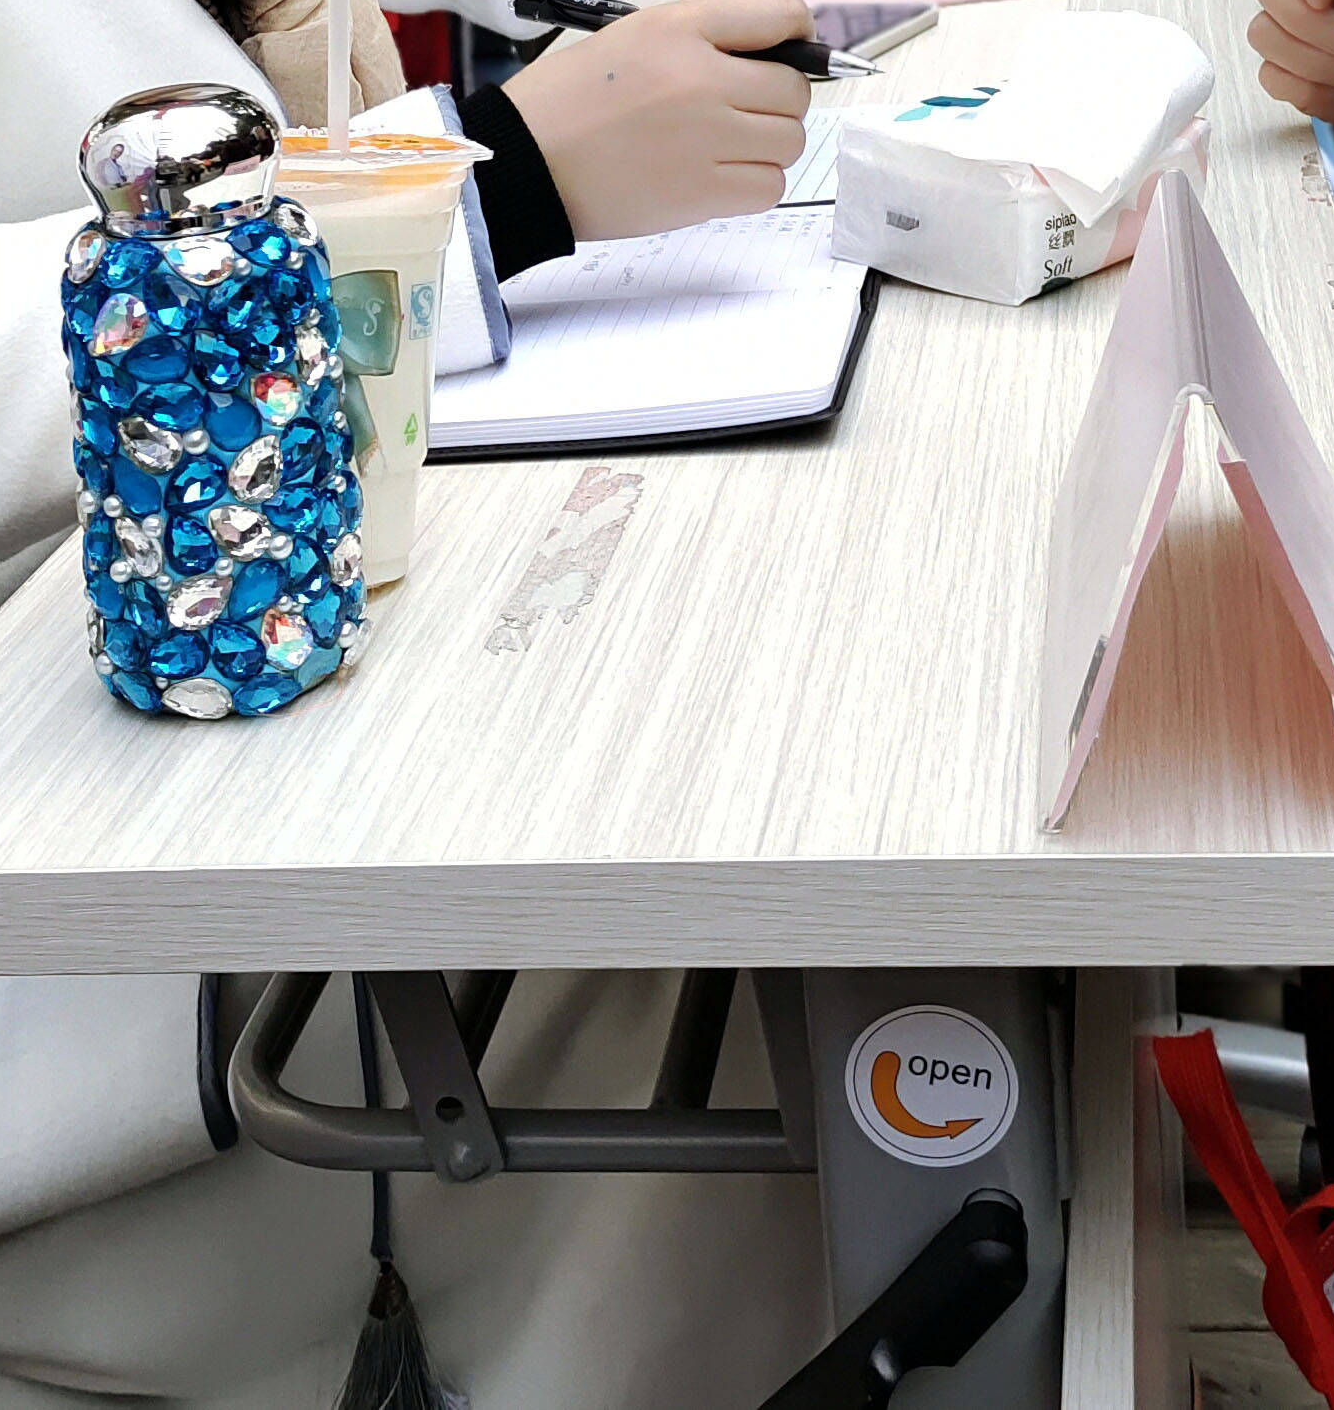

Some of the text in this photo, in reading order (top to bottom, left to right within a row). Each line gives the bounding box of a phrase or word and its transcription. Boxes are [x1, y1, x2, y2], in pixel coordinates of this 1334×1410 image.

[1045, 212, 1077, 232] sipiao
[1043, 255, 1073, 280] Soft
[908, 1055, 991, 1089] open
